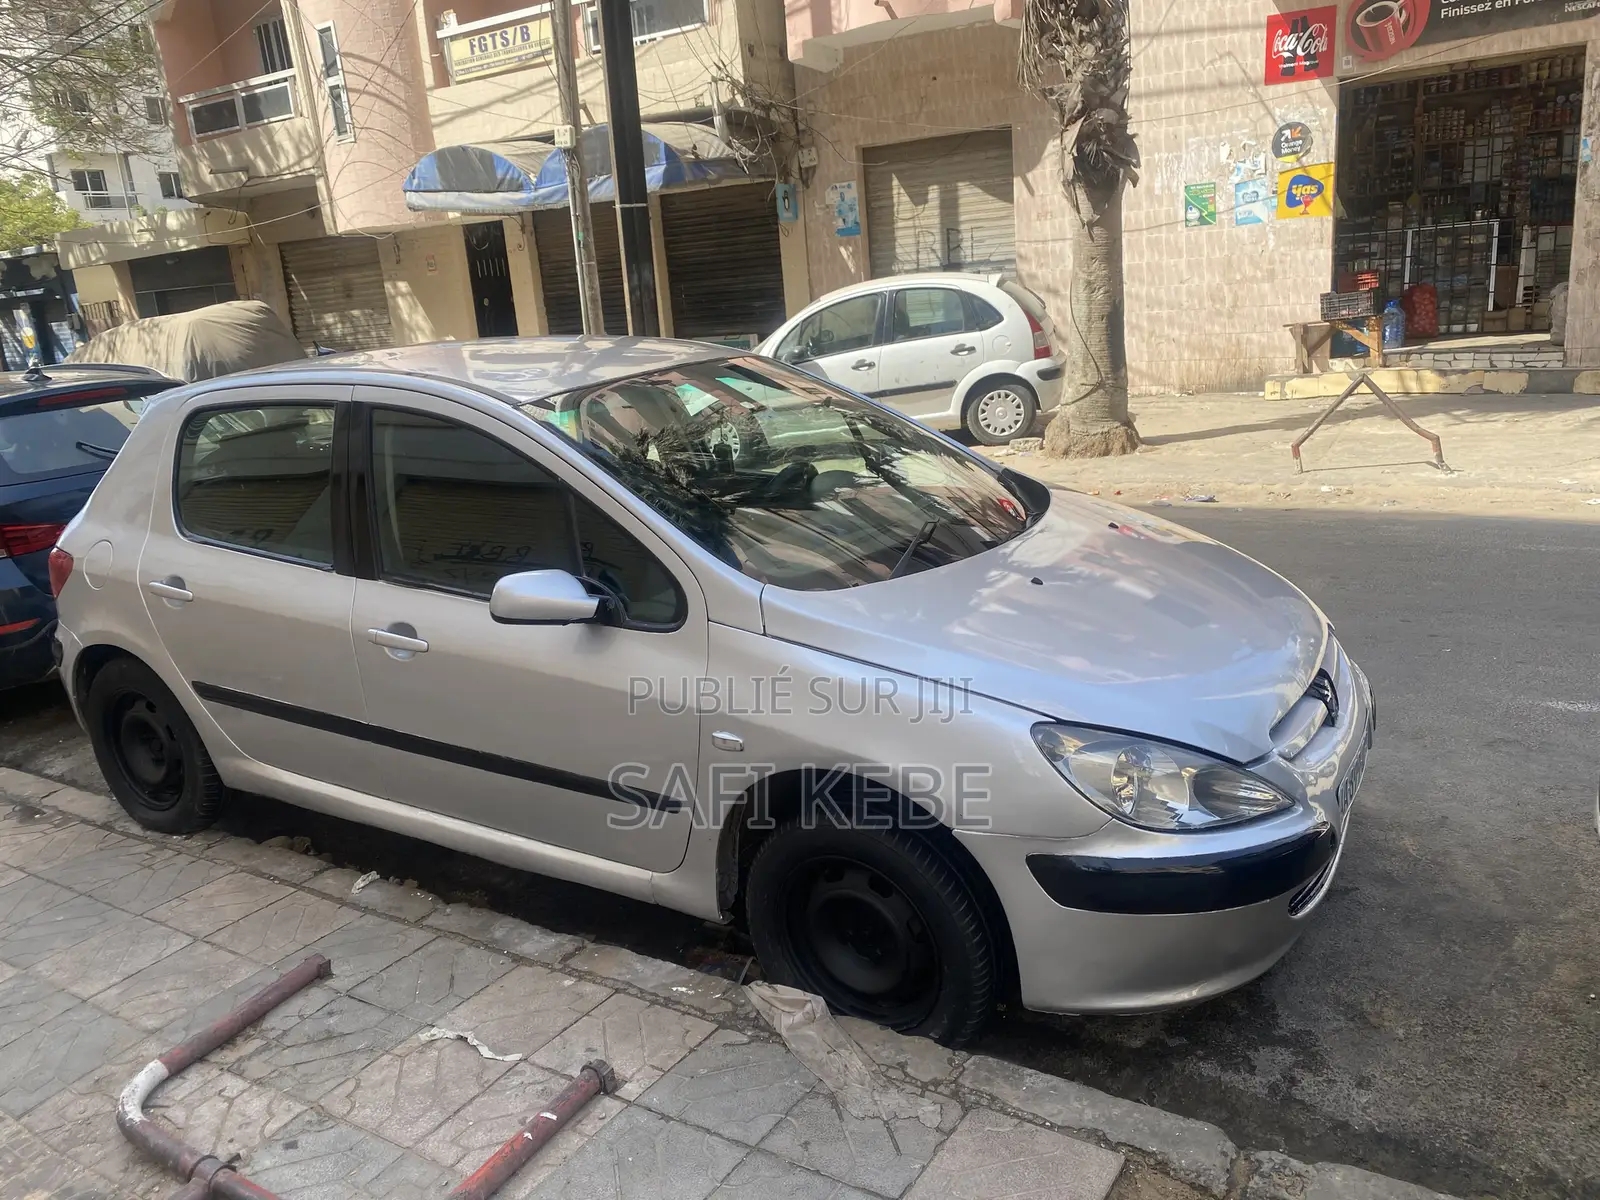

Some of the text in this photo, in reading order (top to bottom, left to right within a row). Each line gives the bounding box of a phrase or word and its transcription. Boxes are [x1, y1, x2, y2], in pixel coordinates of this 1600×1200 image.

[1440, 0, 1512, 19] Finissez en
[468, 25, 531, 55] FGTS/B
[1281, 140, 1303, 149] Orange
[1281, 146, 1301, 155] Money
[1292, 184, 1318, 197] yas
